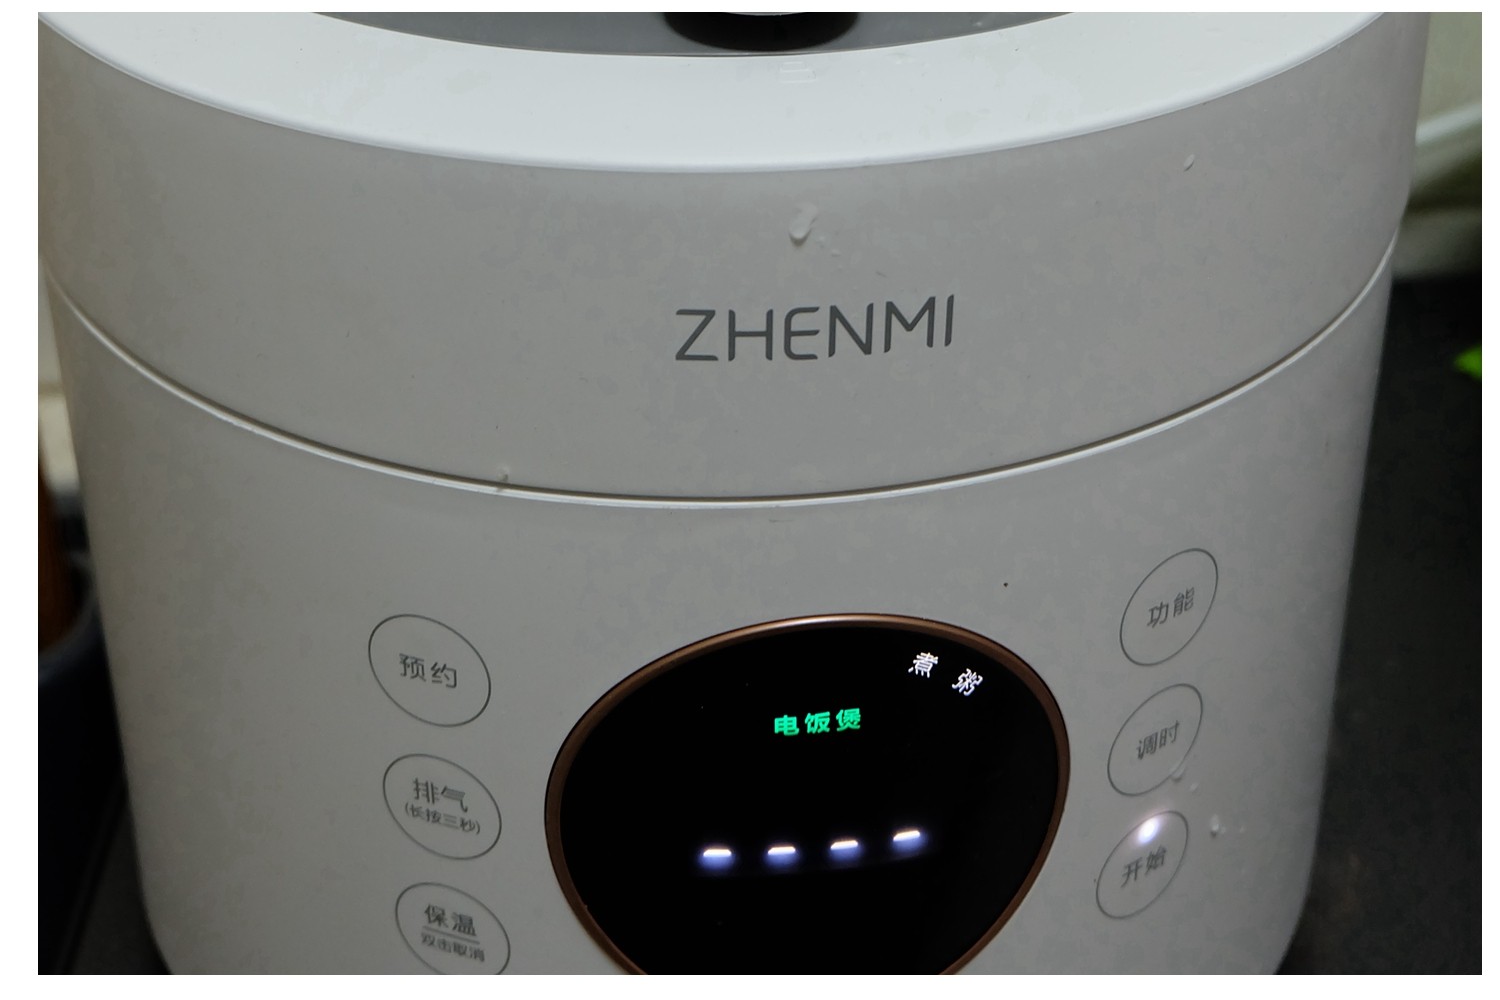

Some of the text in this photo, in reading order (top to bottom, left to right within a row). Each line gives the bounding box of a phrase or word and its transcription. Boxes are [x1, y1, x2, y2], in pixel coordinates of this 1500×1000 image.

[674, 294, 955, 362] ZHENMI
[1146, 586, 1195, 629] 功能
[398, 652, 458, 689] 预约
[773, 707, 862, 736] 电饭煲
[1136, 719, 1180, 761] 调时
[411, 777, 469, 814] 排气
[1120, 845, 1167, 889] 开始
[423, 903, 477, 938] 保温
